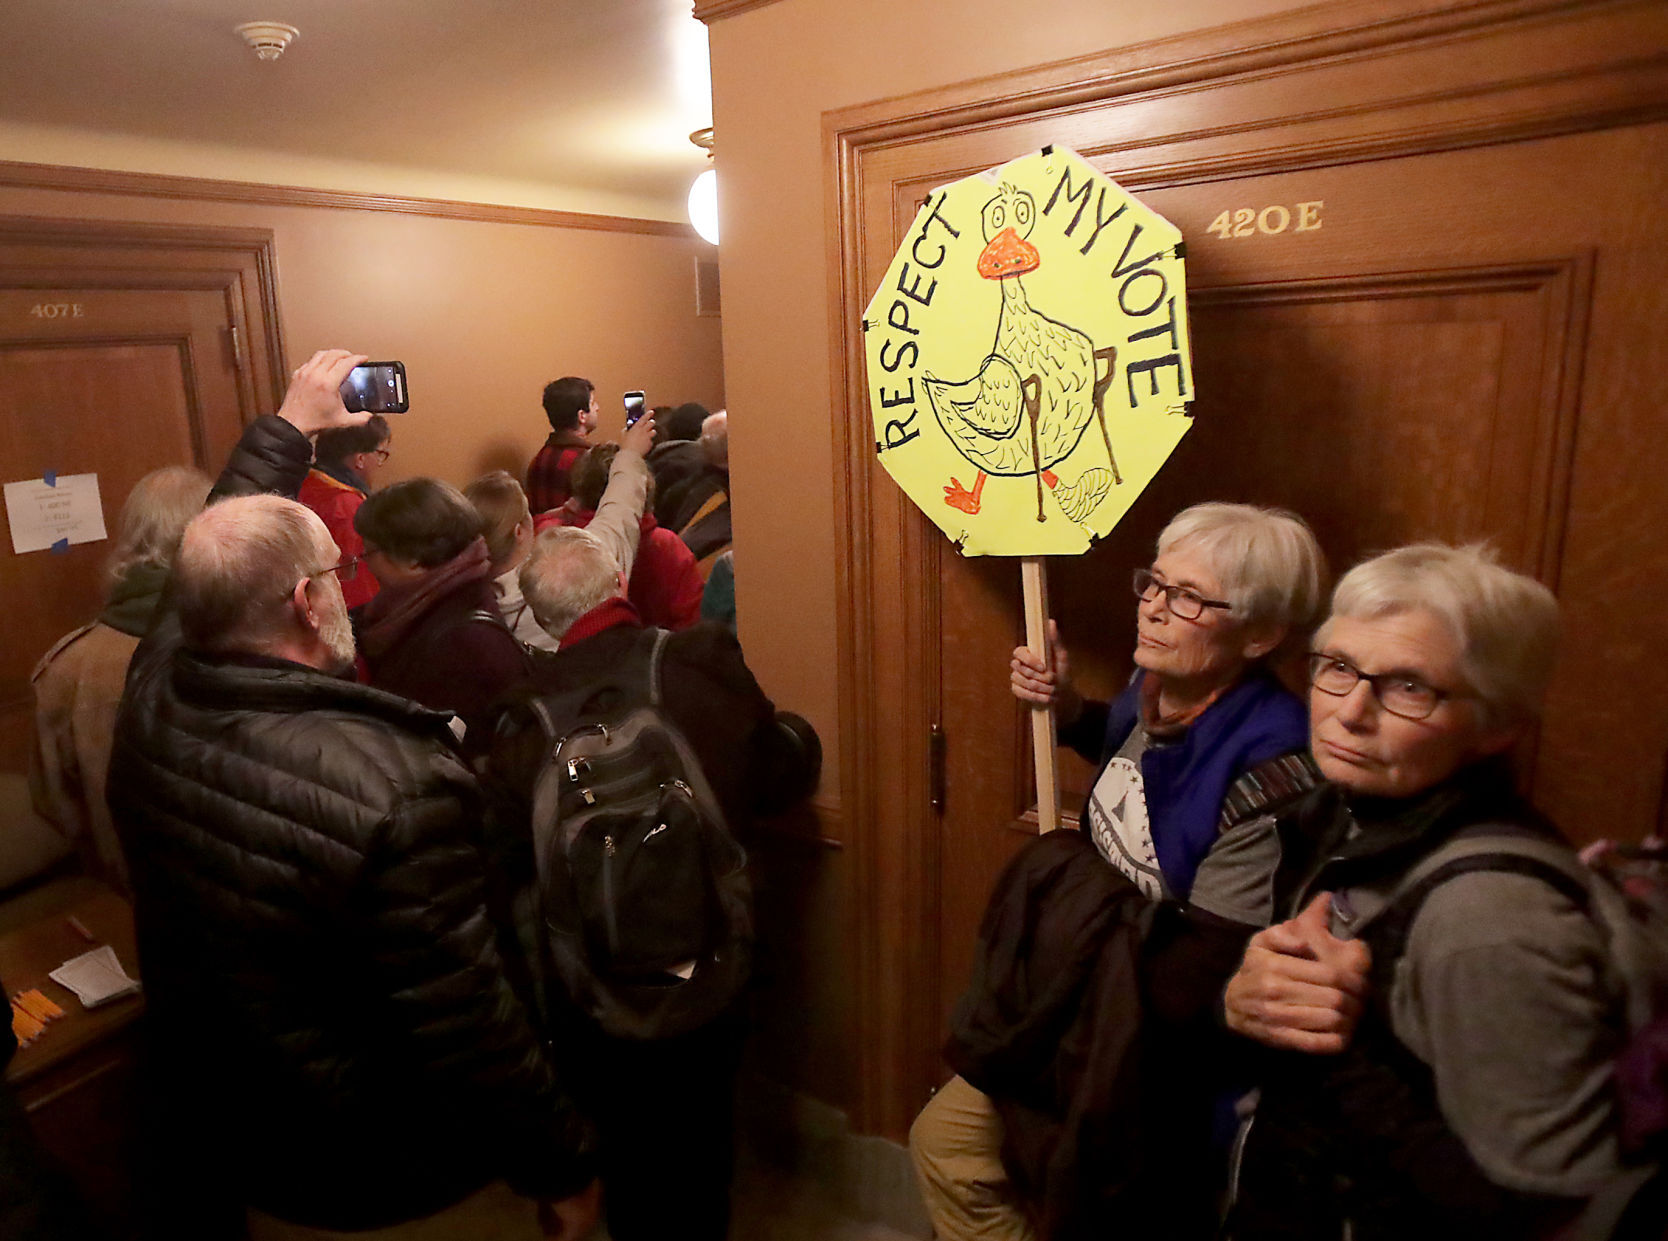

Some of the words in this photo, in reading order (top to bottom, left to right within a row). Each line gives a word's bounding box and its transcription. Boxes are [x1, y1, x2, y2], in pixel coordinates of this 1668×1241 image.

[880, 190, 962, 448] RESPECT
[1042, 165, 1127, 256] MY
[1110, 223, 1187, 408] VOTE
